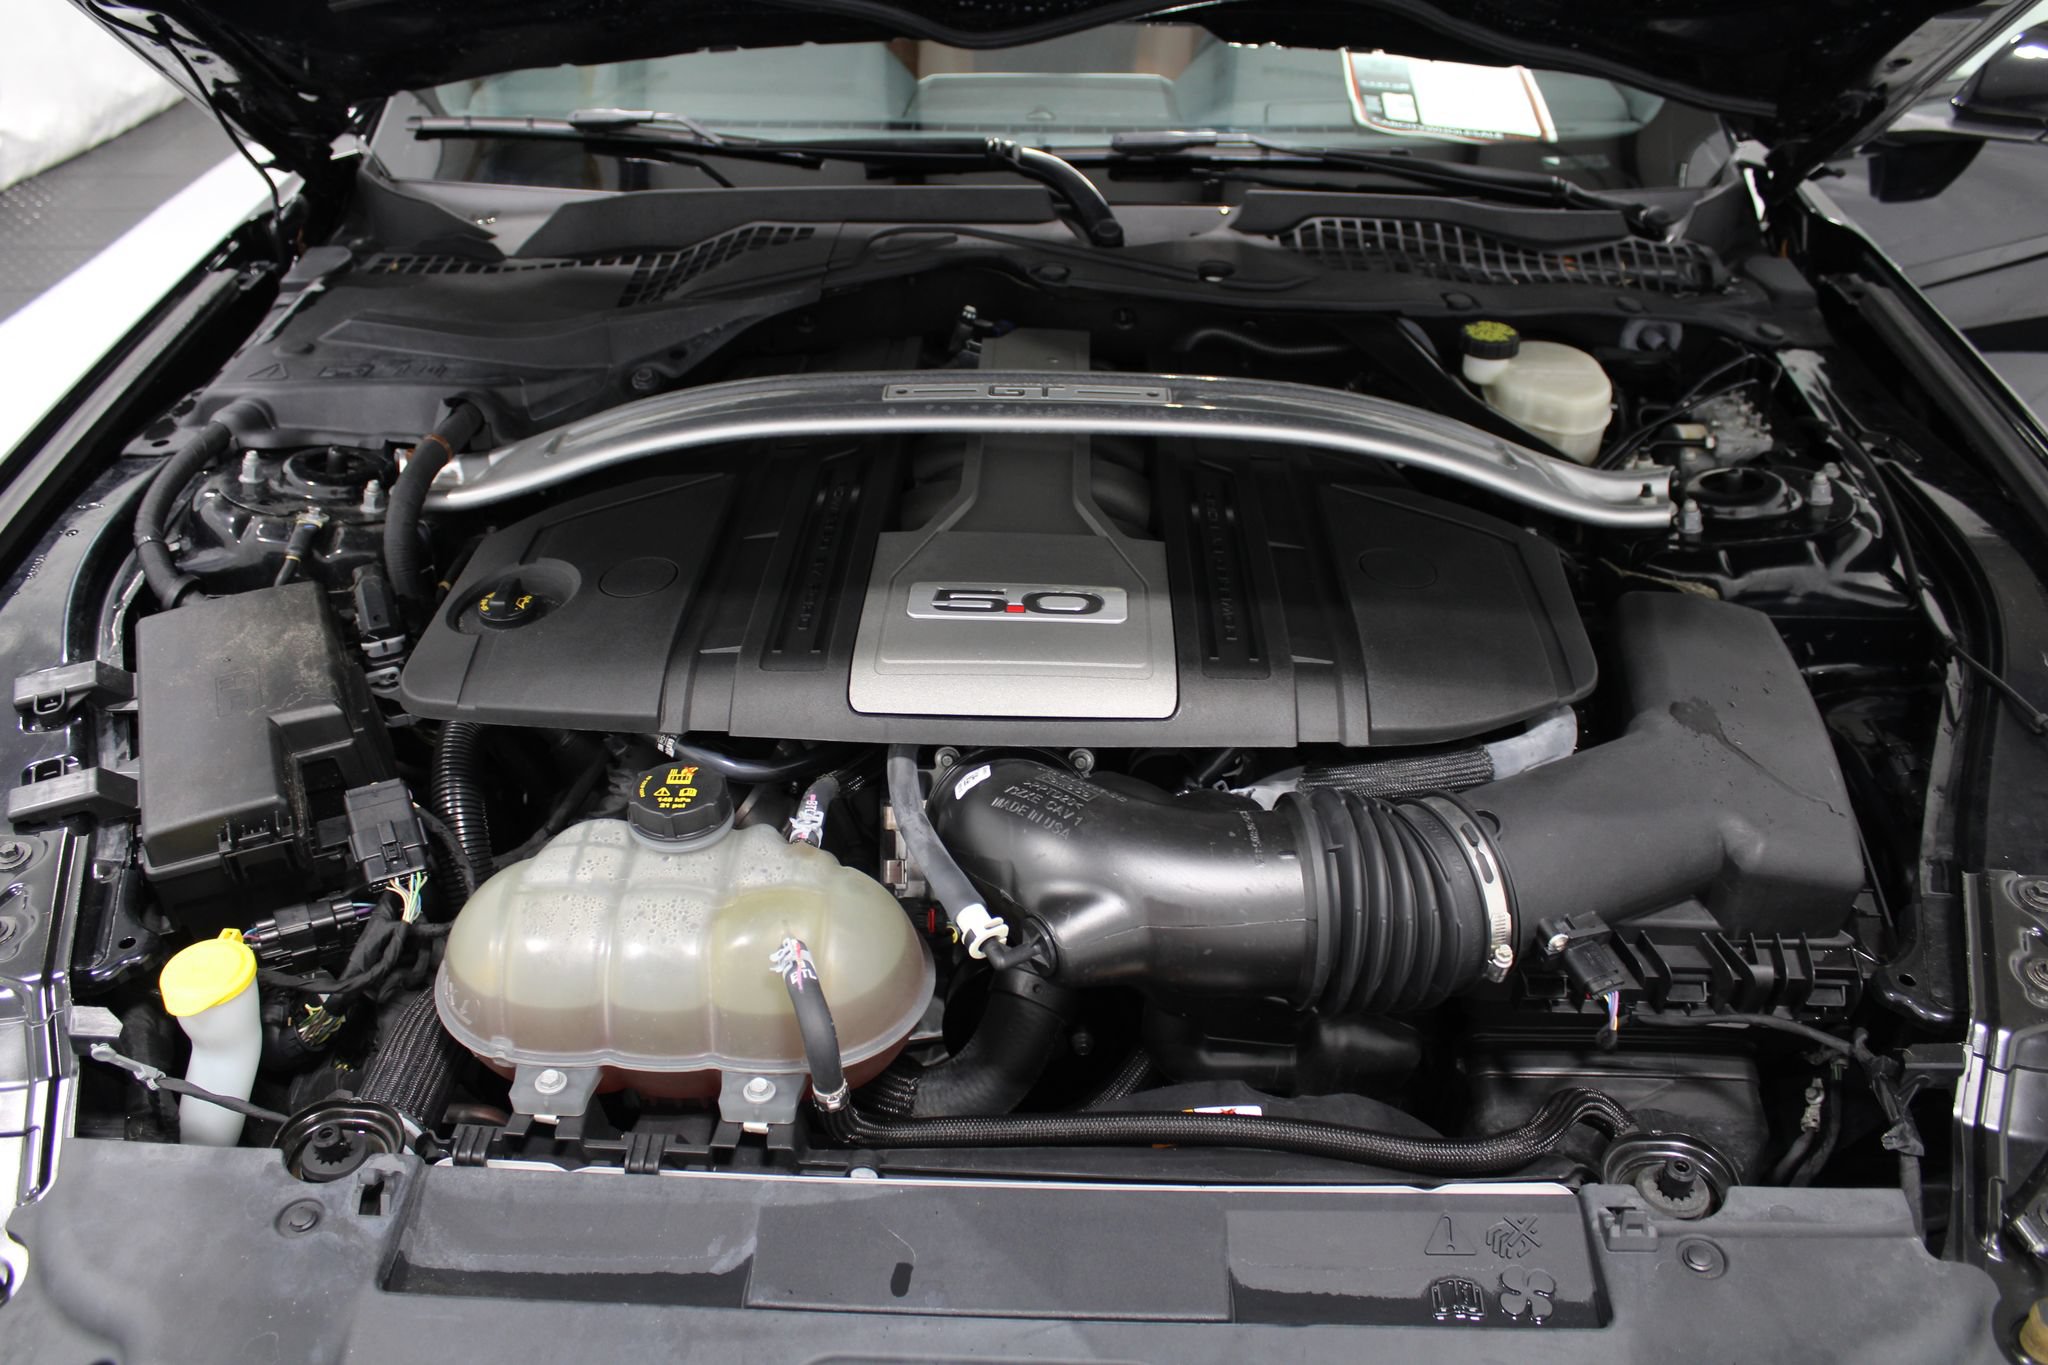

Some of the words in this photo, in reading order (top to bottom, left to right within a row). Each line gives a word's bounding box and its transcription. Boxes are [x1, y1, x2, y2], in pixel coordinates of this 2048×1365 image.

[987, 384, 1066, 398] GT
[931, 587, 1106, 615] 5.0
[991, 796, 1030, 817] MADE
[1027, 809, 1044, 824] IN
[1043, 816, 1071, 841] USA
[1045, 800, 1075, 820] CAV
